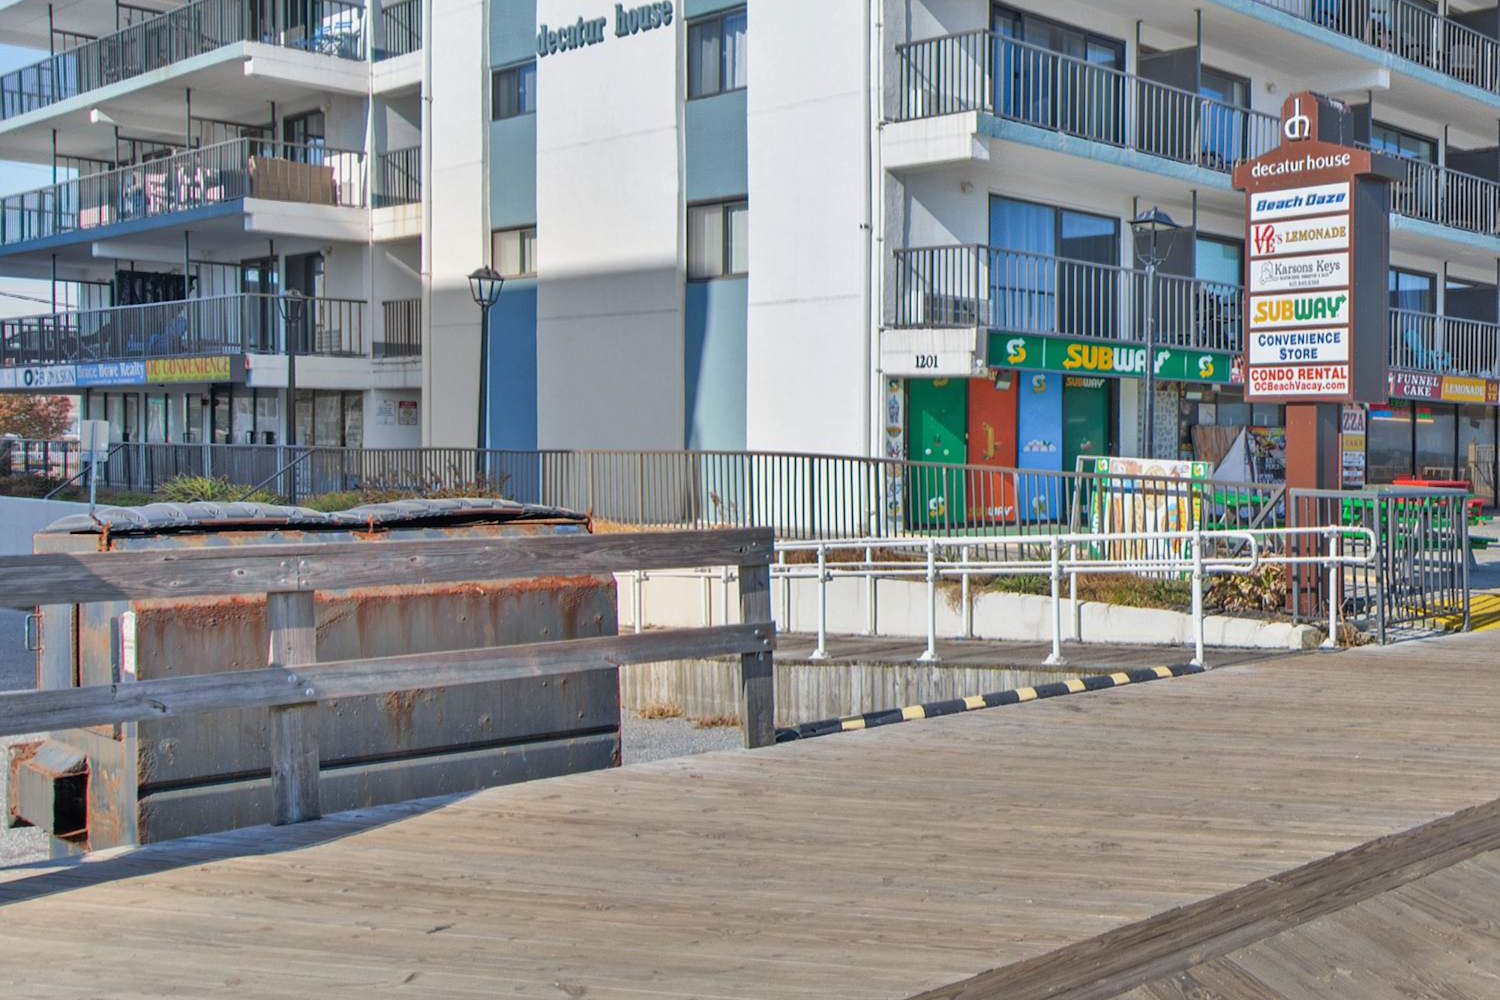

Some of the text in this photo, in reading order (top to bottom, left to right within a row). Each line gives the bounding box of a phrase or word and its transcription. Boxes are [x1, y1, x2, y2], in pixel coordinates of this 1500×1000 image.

[536, 0, 673, 58] decatur house
[1251, 153, 1350, 178] decatur house
[1256, 193, 1346, 212] Beach Daze
[1285, 226, 1346, 243] LEMONADE
[1275, 260, 1341, 276] Karsons Keys
[1253, 294, 1347, 323] SUBWAY
[1258, 332, 1341, 347] CONVENIENCE
[915, 354, 938, 369] 1201
[1062, 343, 1171, 375] SUBWAY
[1279, 348, 1318, 361] STORE
[1065, 376, 1106, 388] SUBWAY
[1251, 368, 1347, 381] CONDO RENTAL
[1397, 374, 1439, 387] FUNNEL
[1254, 381, 1345, 391] OCBeachVacay.com
[1403, 385, 1432, 397] CAKE
[1444, 383, 1484, 395] LEMONADE
[1343, 412, 1365, 432] ZZA
